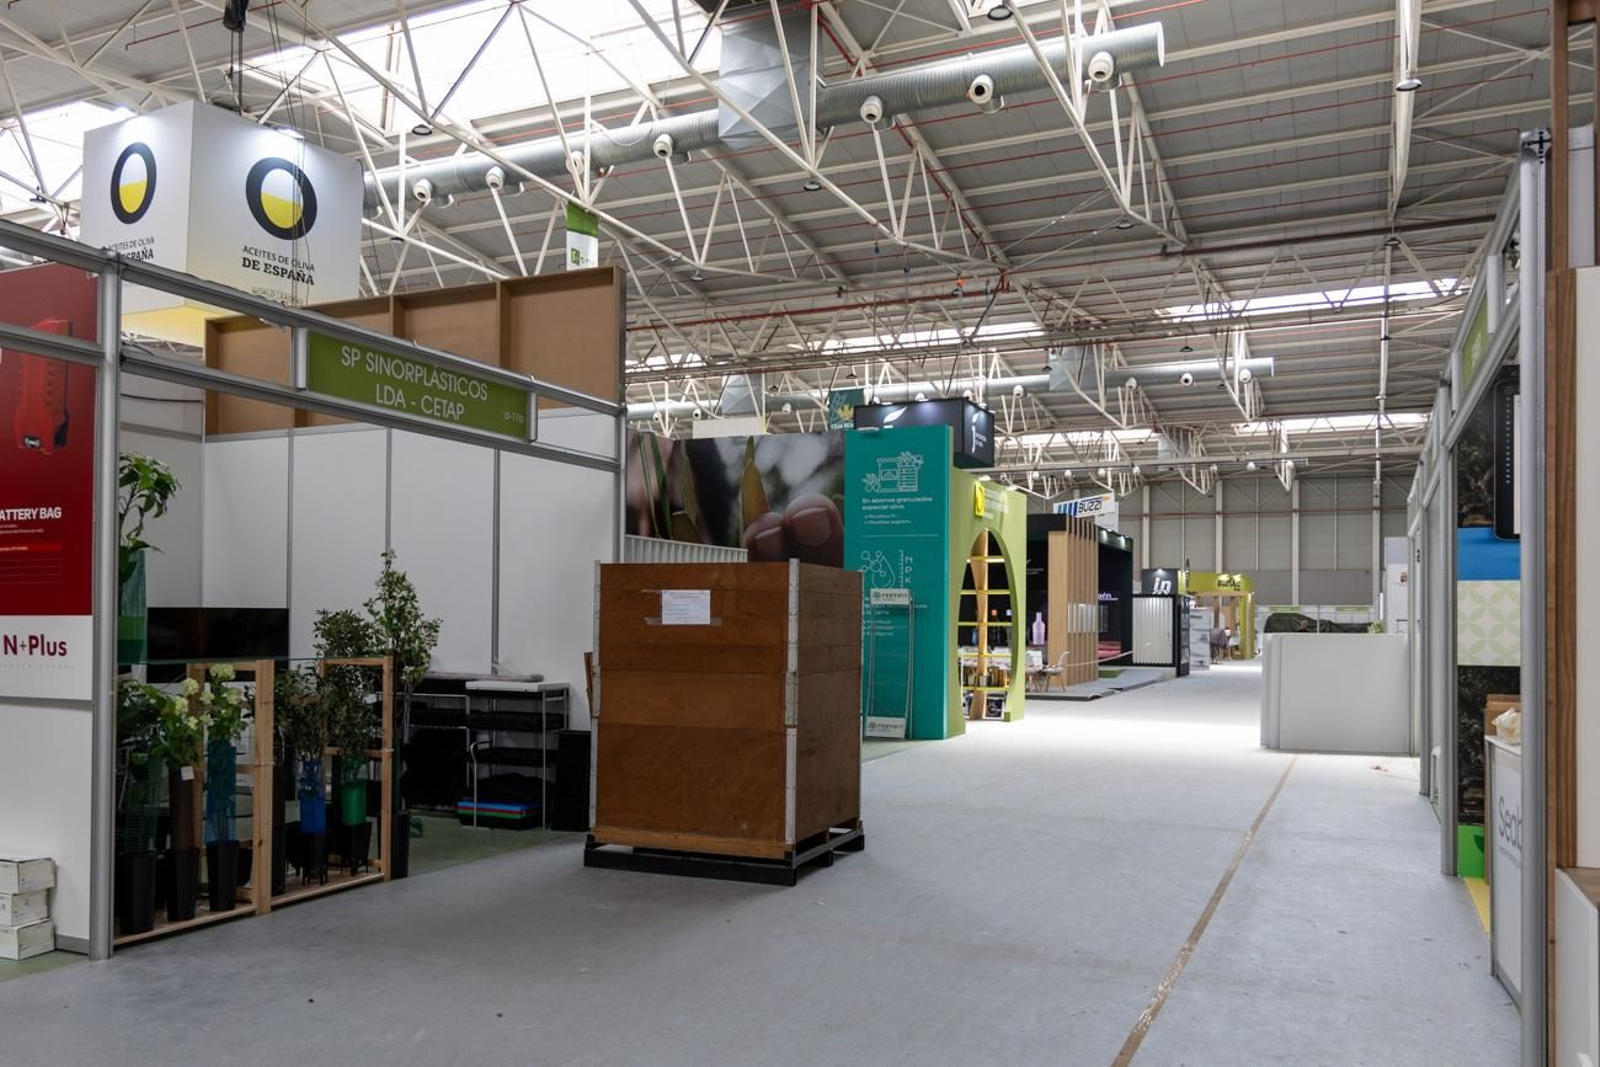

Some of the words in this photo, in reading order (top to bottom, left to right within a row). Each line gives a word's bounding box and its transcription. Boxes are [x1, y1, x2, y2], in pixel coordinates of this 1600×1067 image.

[242, 256, 261, 271] DE
[263, 262, 315, 286] ESPAÑA
[243, 245, 277, 262] ACEITES
[278, 255, 290, 265] DE
[292, 259, 315, 272] OLIVA
[341, 345, 361, 367] SP
[375, 383, 406, 409] LDA
[421, 394, 465, 420] CETAP
[39, 506, 62, 519] BAG
[3, 634, 68, 657] N+Plus
